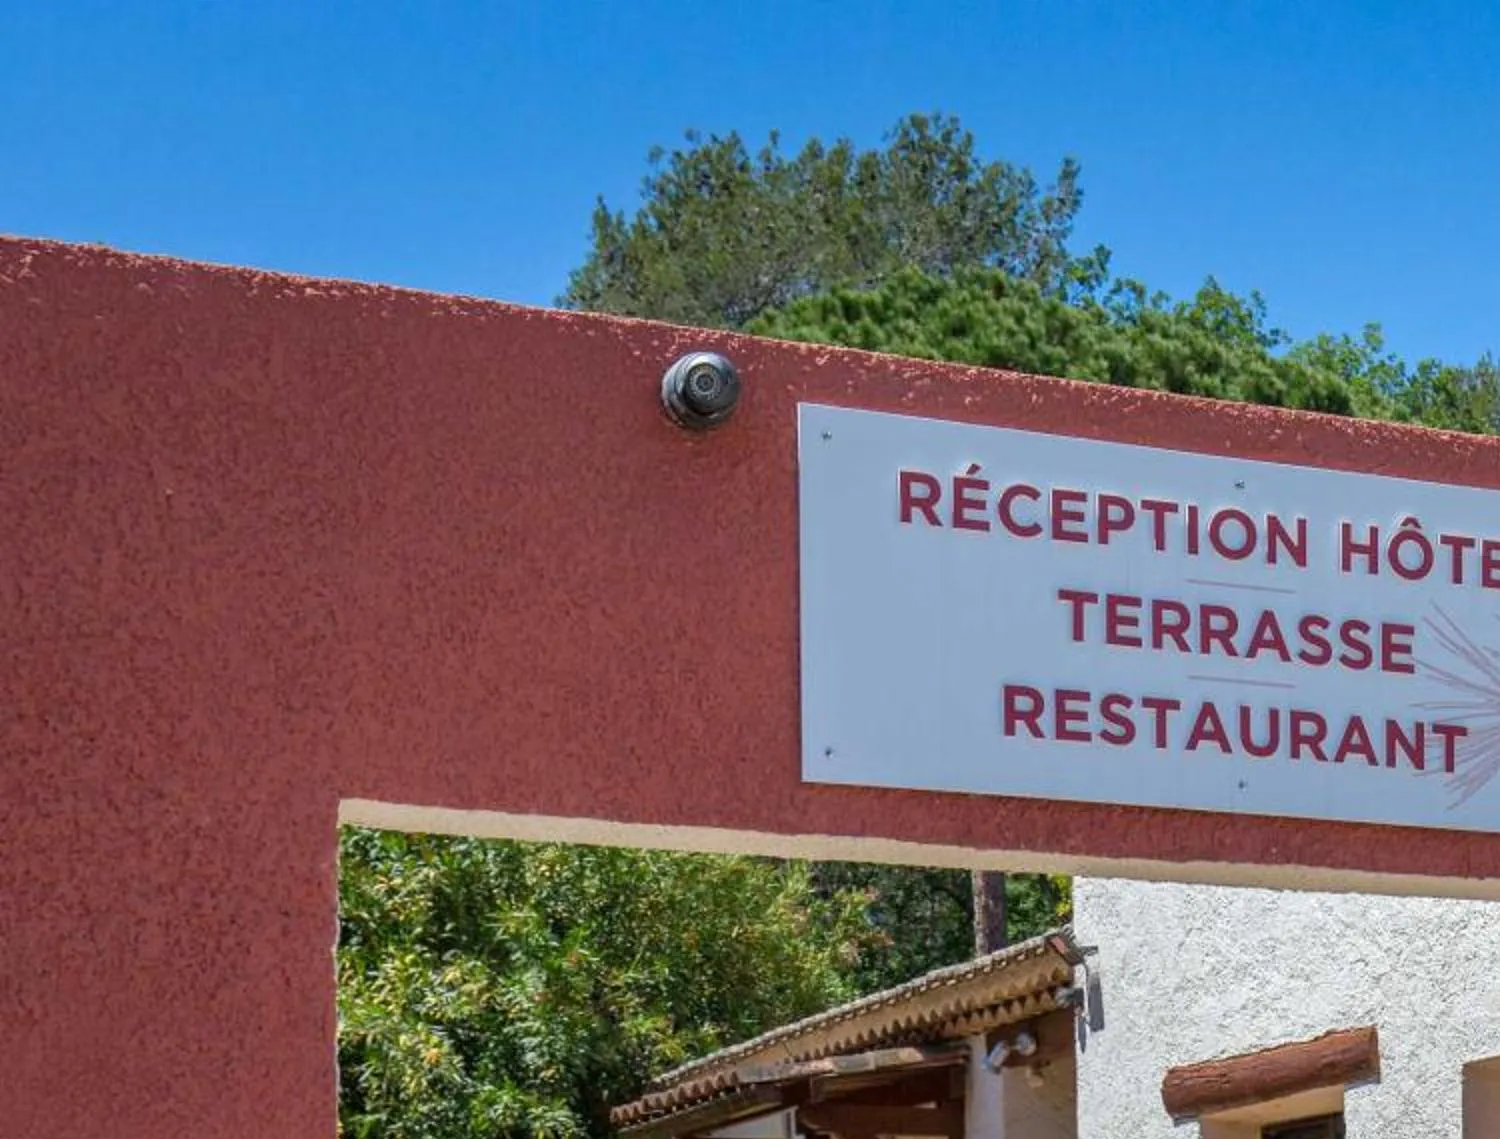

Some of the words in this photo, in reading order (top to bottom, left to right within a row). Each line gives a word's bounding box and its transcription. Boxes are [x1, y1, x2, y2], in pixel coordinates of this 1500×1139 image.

[898, 464, 1308, 569] RÉCEPTION
[1057, 589, 1416, 675] TERRASSE
[1003, 684, 1469, 774] RESTAURANT
